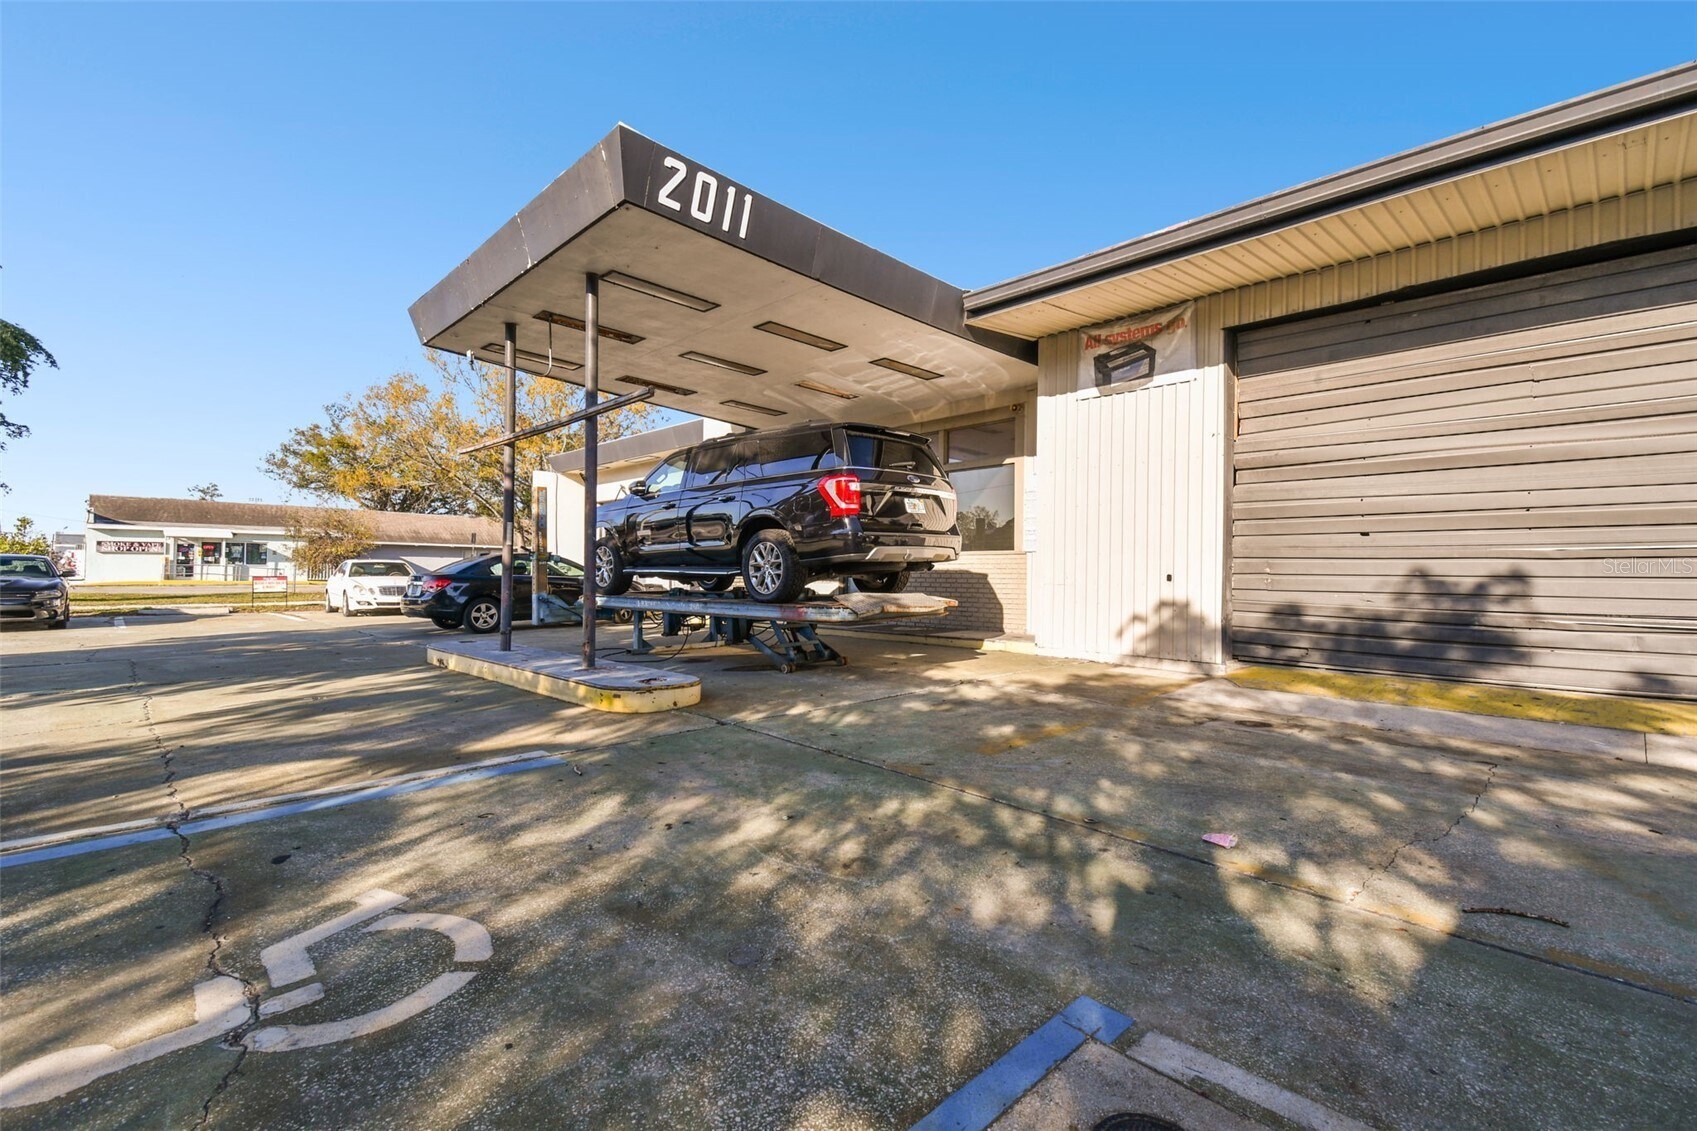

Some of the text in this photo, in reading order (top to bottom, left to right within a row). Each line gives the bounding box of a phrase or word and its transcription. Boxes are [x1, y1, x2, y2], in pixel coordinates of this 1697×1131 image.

[658, 156, 753, 239] 2011
[1084, 333, 1102, 351] All
[1105, 322, 1163, 346] systems
